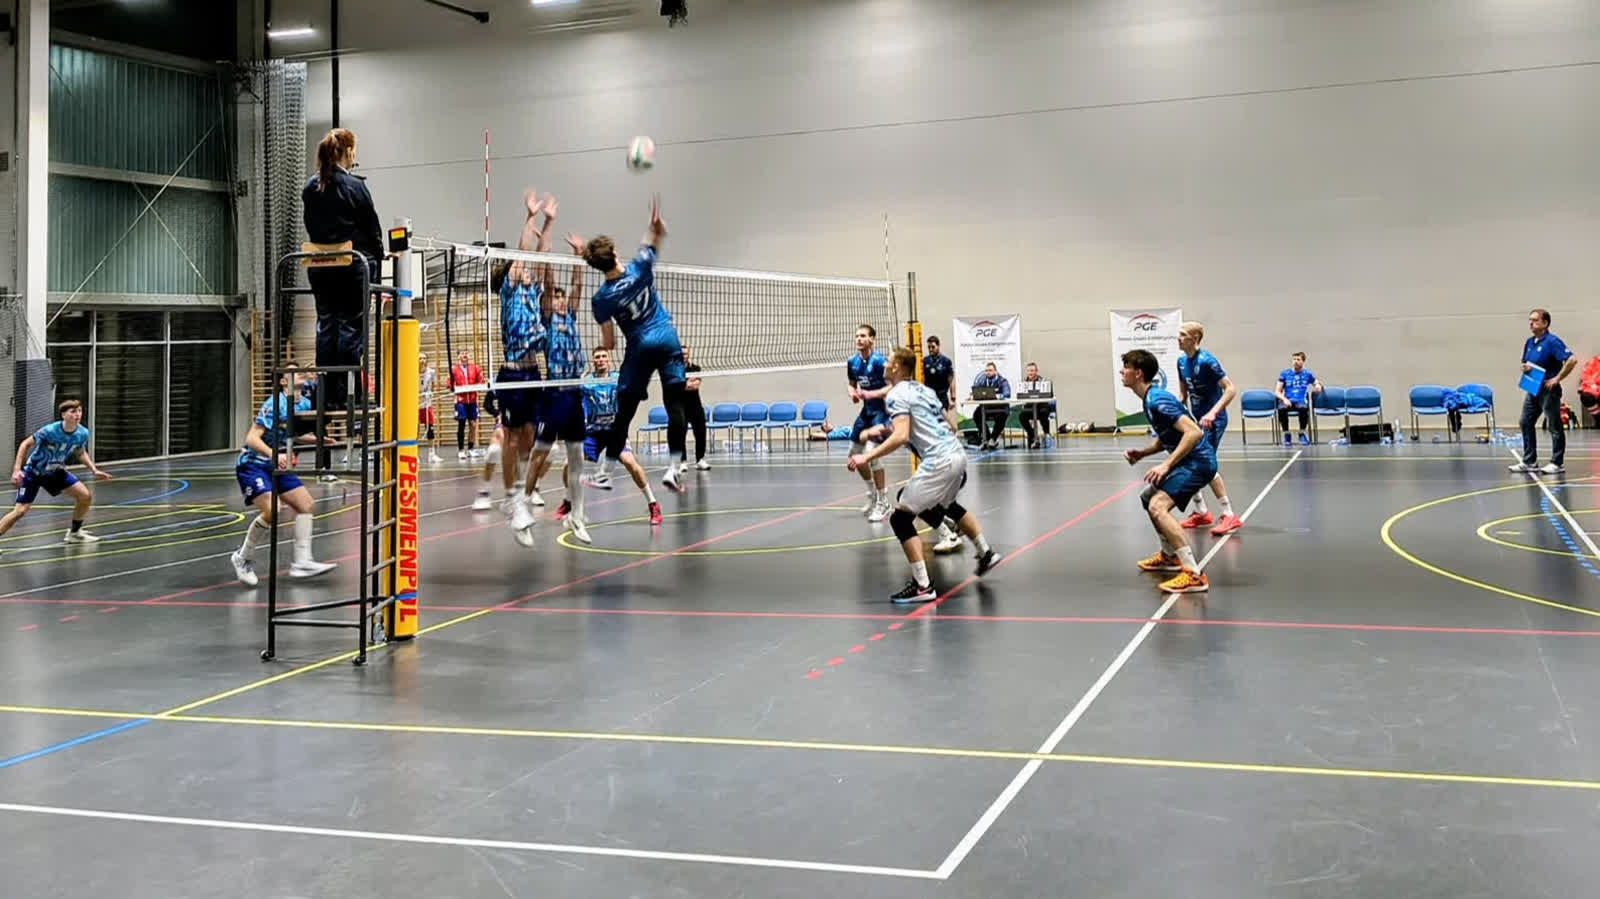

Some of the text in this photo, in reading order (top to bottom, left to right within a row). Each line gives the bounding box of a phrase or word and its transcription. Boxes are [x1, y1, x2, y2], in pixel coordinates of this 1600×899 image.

[627, 286, 650, 320] 17
[975, 328, 998, 338] PGE
[1134, 321, 1158, 331] PGE
[399, 454, 418, 622] PESMENPOL
